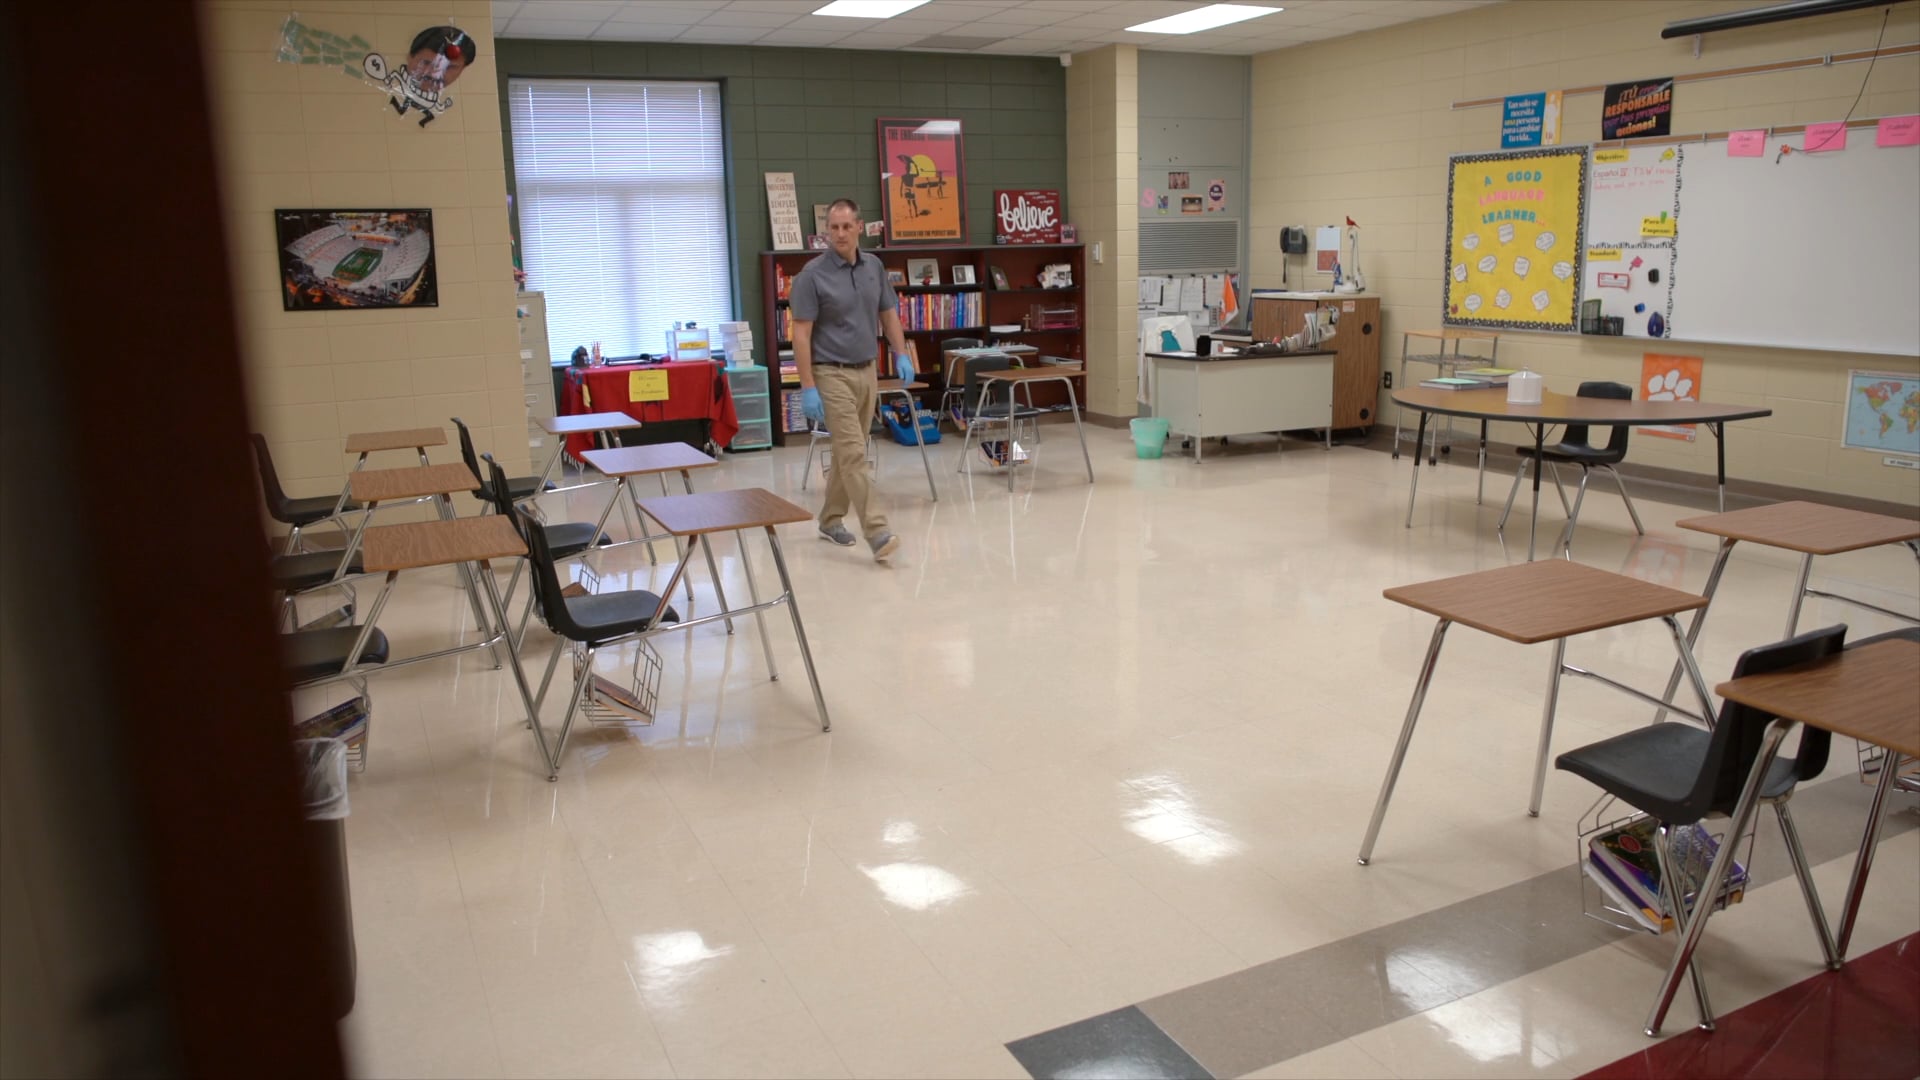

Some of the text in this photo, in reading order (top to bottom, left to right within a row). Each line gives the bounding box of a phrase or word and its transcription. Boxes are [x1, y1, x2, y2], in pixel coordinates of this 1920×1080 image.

[1508, 100, 1518, 109] Tan
[1605, 88, 1671, 117] RESPONSABLE
[1510, 108, 1535, 117] necesita
[1603, 104, 1670, 128] por tus propias
[1516, 116, 1540, 126] persona
[1616, 115, 1656, 137] acciones!
[1503, 124, 1541, 136] para cambiar
[1485, 171, 1541, 187] A GOOD
[770, 200, 796, 208] SIMPLES
[1478, 189, 1544, 206] LANGUAGE
[997, 193, 1058, 232] believe
[777, 232, 798, 244] VIDA
